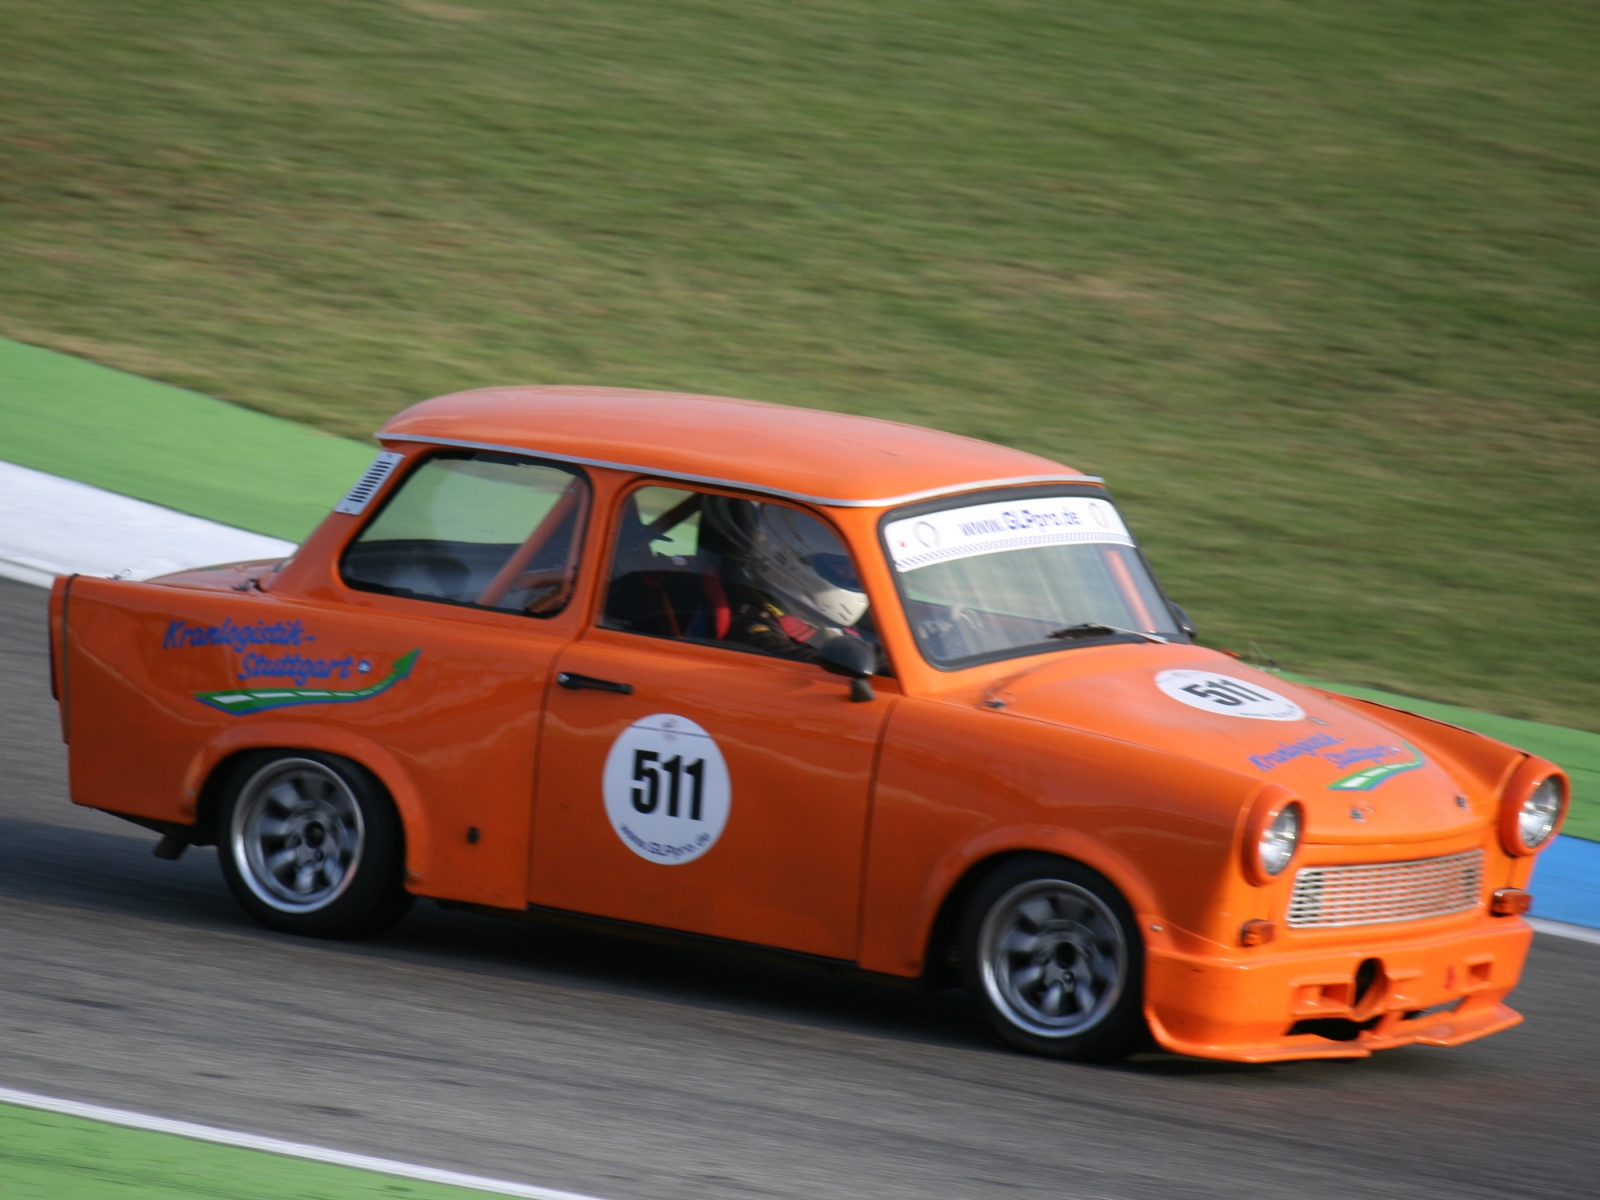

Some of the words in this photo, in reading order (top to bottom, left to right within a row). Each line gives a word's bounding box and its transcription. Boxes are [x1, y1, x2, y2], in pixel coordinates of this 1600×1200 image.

[237, 653, 354, 686] Stuttgart
[1179, 678, 1275, 706] 511
[631, 748, 706, 821] 511
